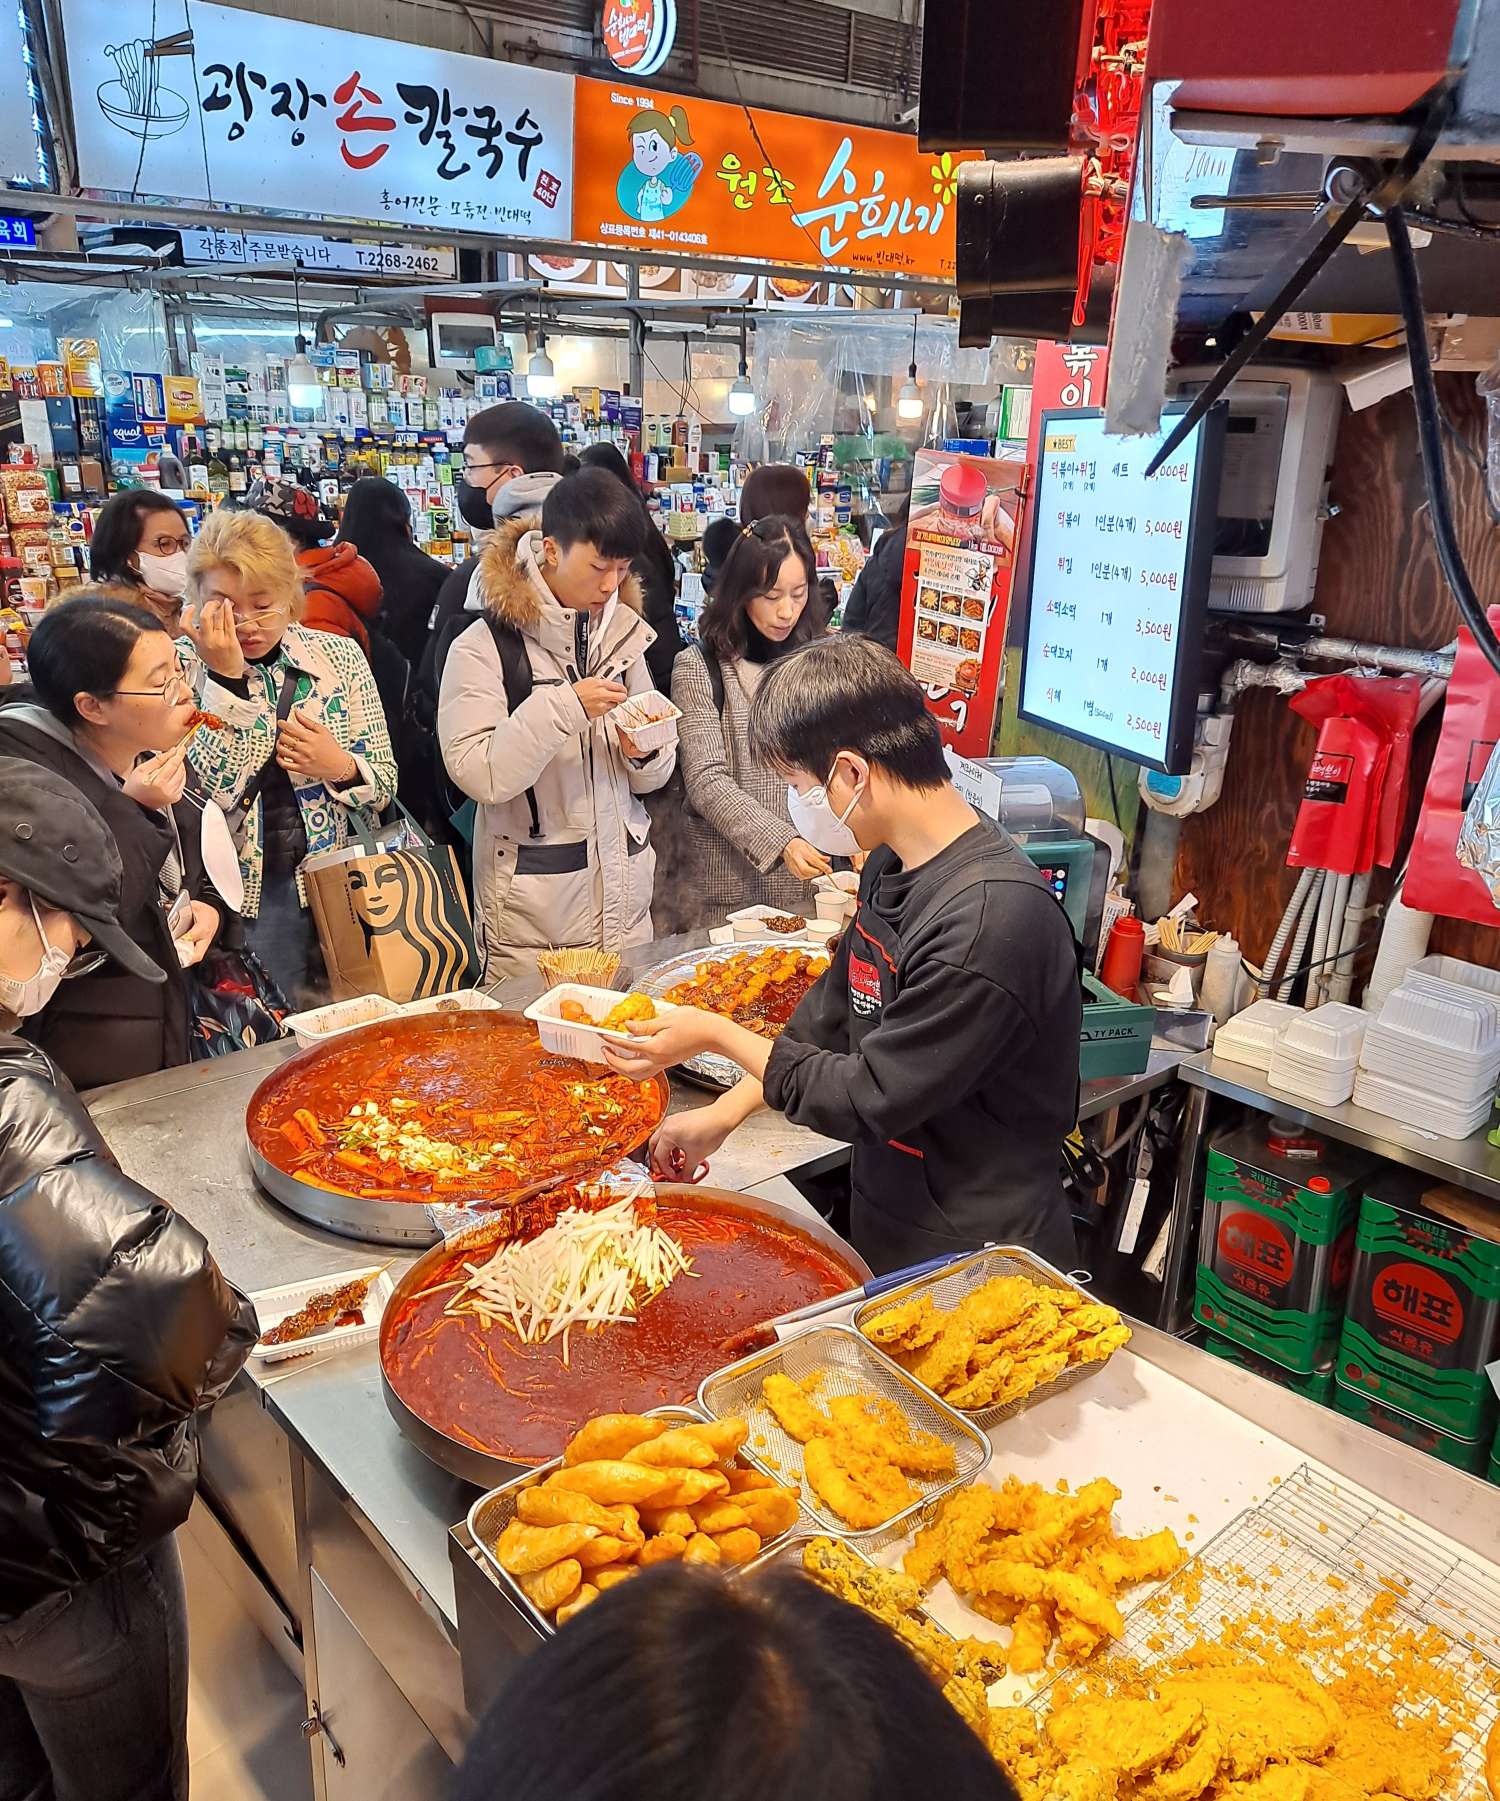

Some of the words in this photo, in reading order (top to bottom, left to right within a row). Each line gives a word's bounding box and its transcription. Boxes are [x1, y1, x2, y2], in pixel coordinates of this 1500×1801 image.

[611, 92, 634, 105] Since
[636, 97, 654, 109] 1994
[716, 152, 796, 209] 원조
[200, 238, 243, 258] 각종전
[248, 239, 331, 263] 주문받습니다
[356, 251, 439, 272] T.2268-2462
[113, 425, 141, 439] equal
[1057, 439, 1073, 449] BEST
[1111, 462, 1129, 477] 세트
[1058, 512, 1080, 528] 떡볶이
[1096, 514, 1137, 533] 1인분(4개)
[1145, 520, 1182, 539] 5,000원
[1058, 557, 1073, 574] 튀김
[1091, 562, 1132, 582] 1인분(4개)
[1140, 570, 1177, 591] 5,000원
[1046, 600, 1076, 620] 소떡소떡
[1101, 612, 1113, 625] 1개
[1136, 619, 1172, 641] 3,500원
[1097, 658, 1108, 672] 1개
[1131, 667, 1166, 691] 2,000원
[1127, 714, 1161, 739] 2,500원
[1108, 1026, 1134, 1037] PACK
[1226, 1225, 1286, 1272] 해표
[1383, 1277, 1454, 1329] 해표
